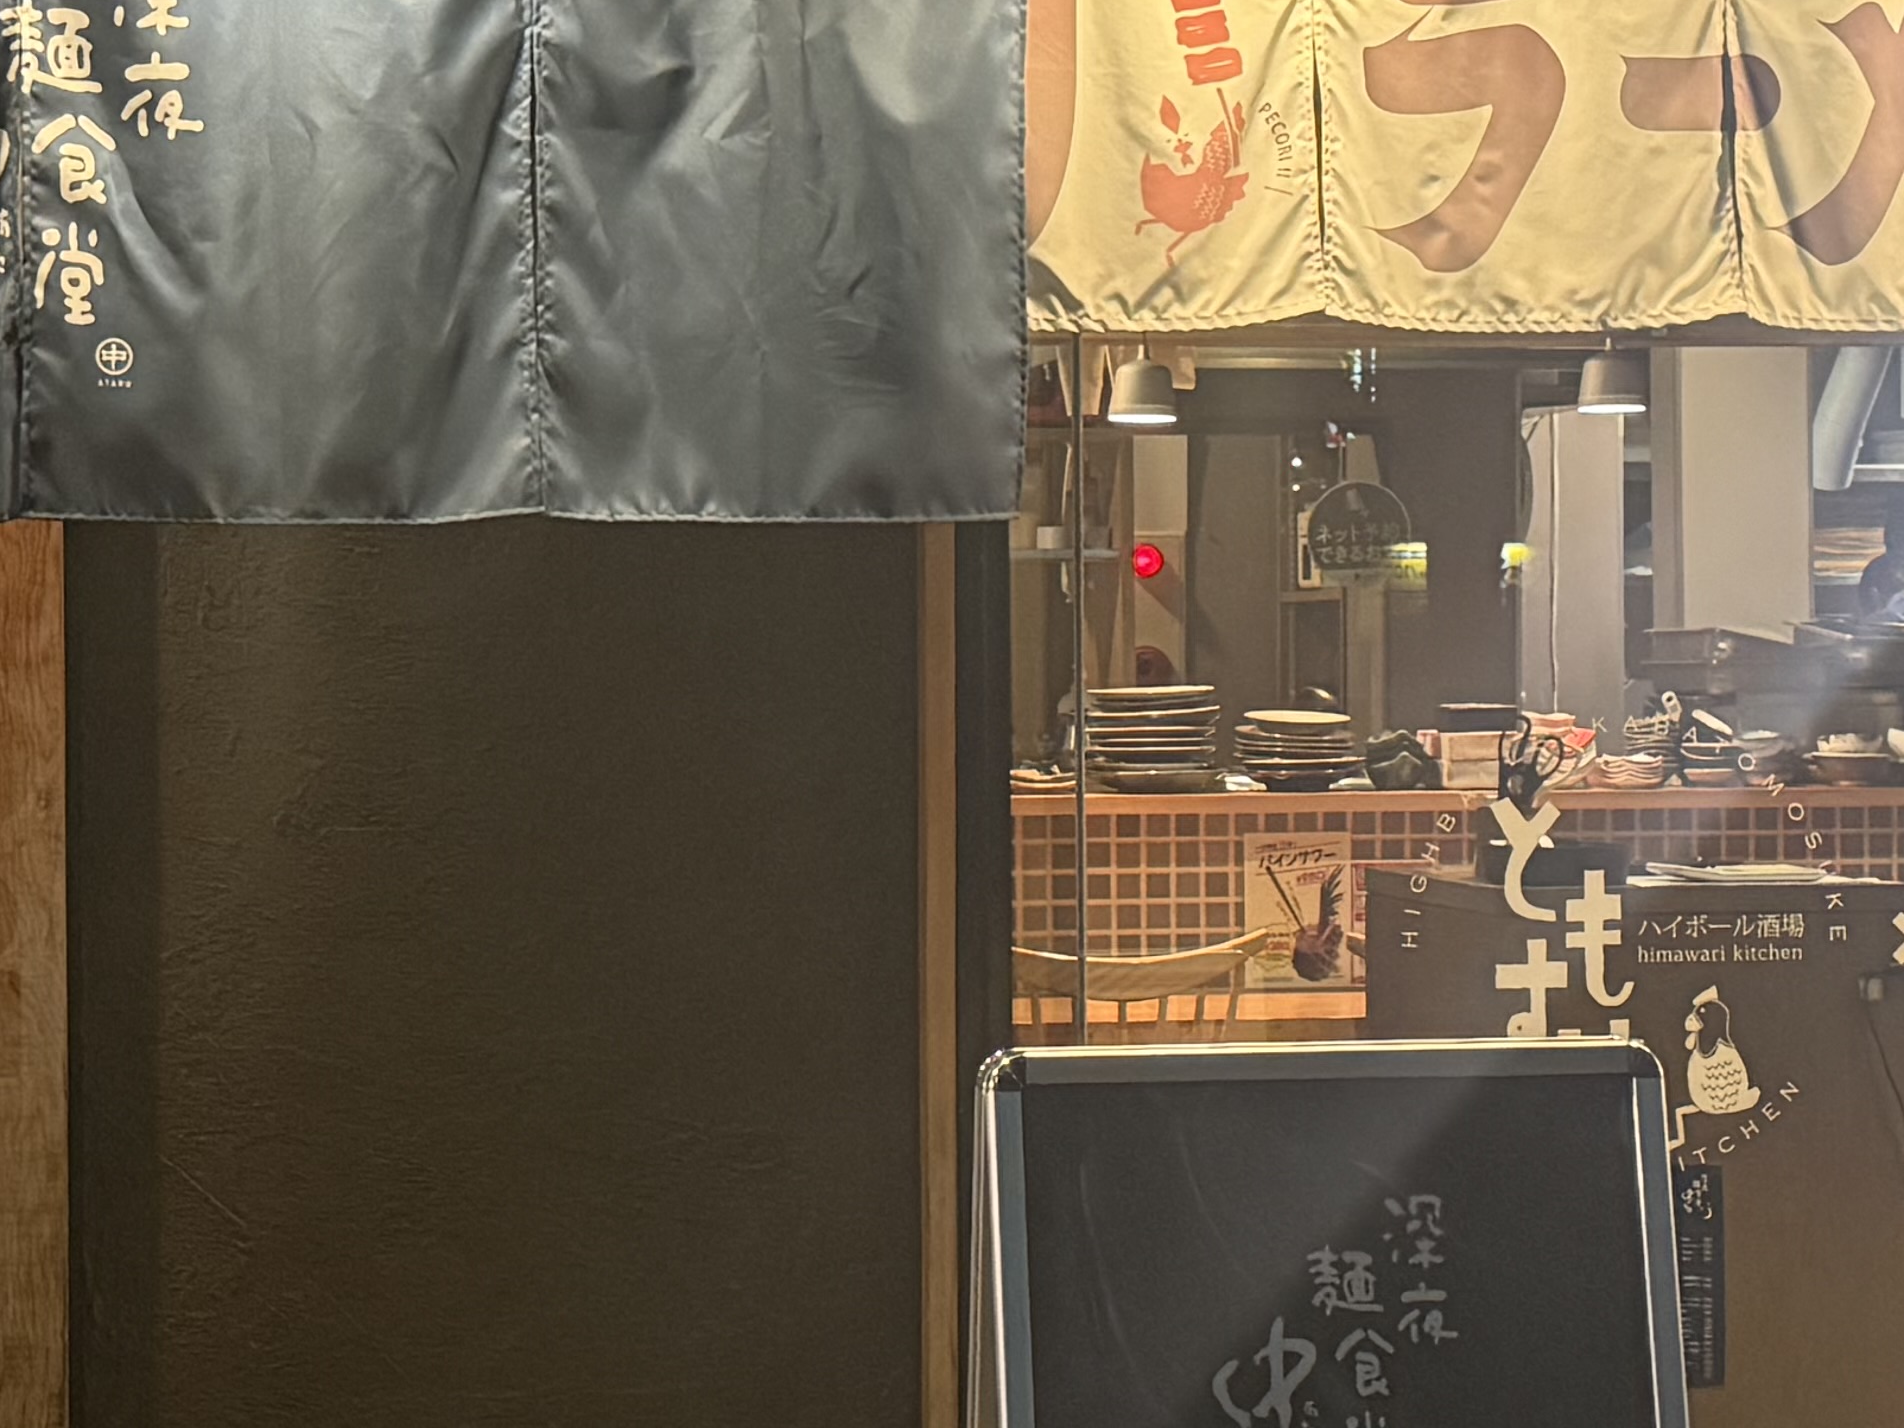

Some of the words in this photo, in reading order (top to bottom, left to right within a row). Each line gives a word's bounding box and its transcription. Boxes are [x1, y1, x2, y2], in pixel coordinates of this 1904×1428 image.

[1638, 913, 1805, 939] ハイボール酒場
[1637, 945, 1726, 964] himawari
[1733, 942, 1804, 963] kitchen
[1382, 1194, 1459, 1346] 深夜
